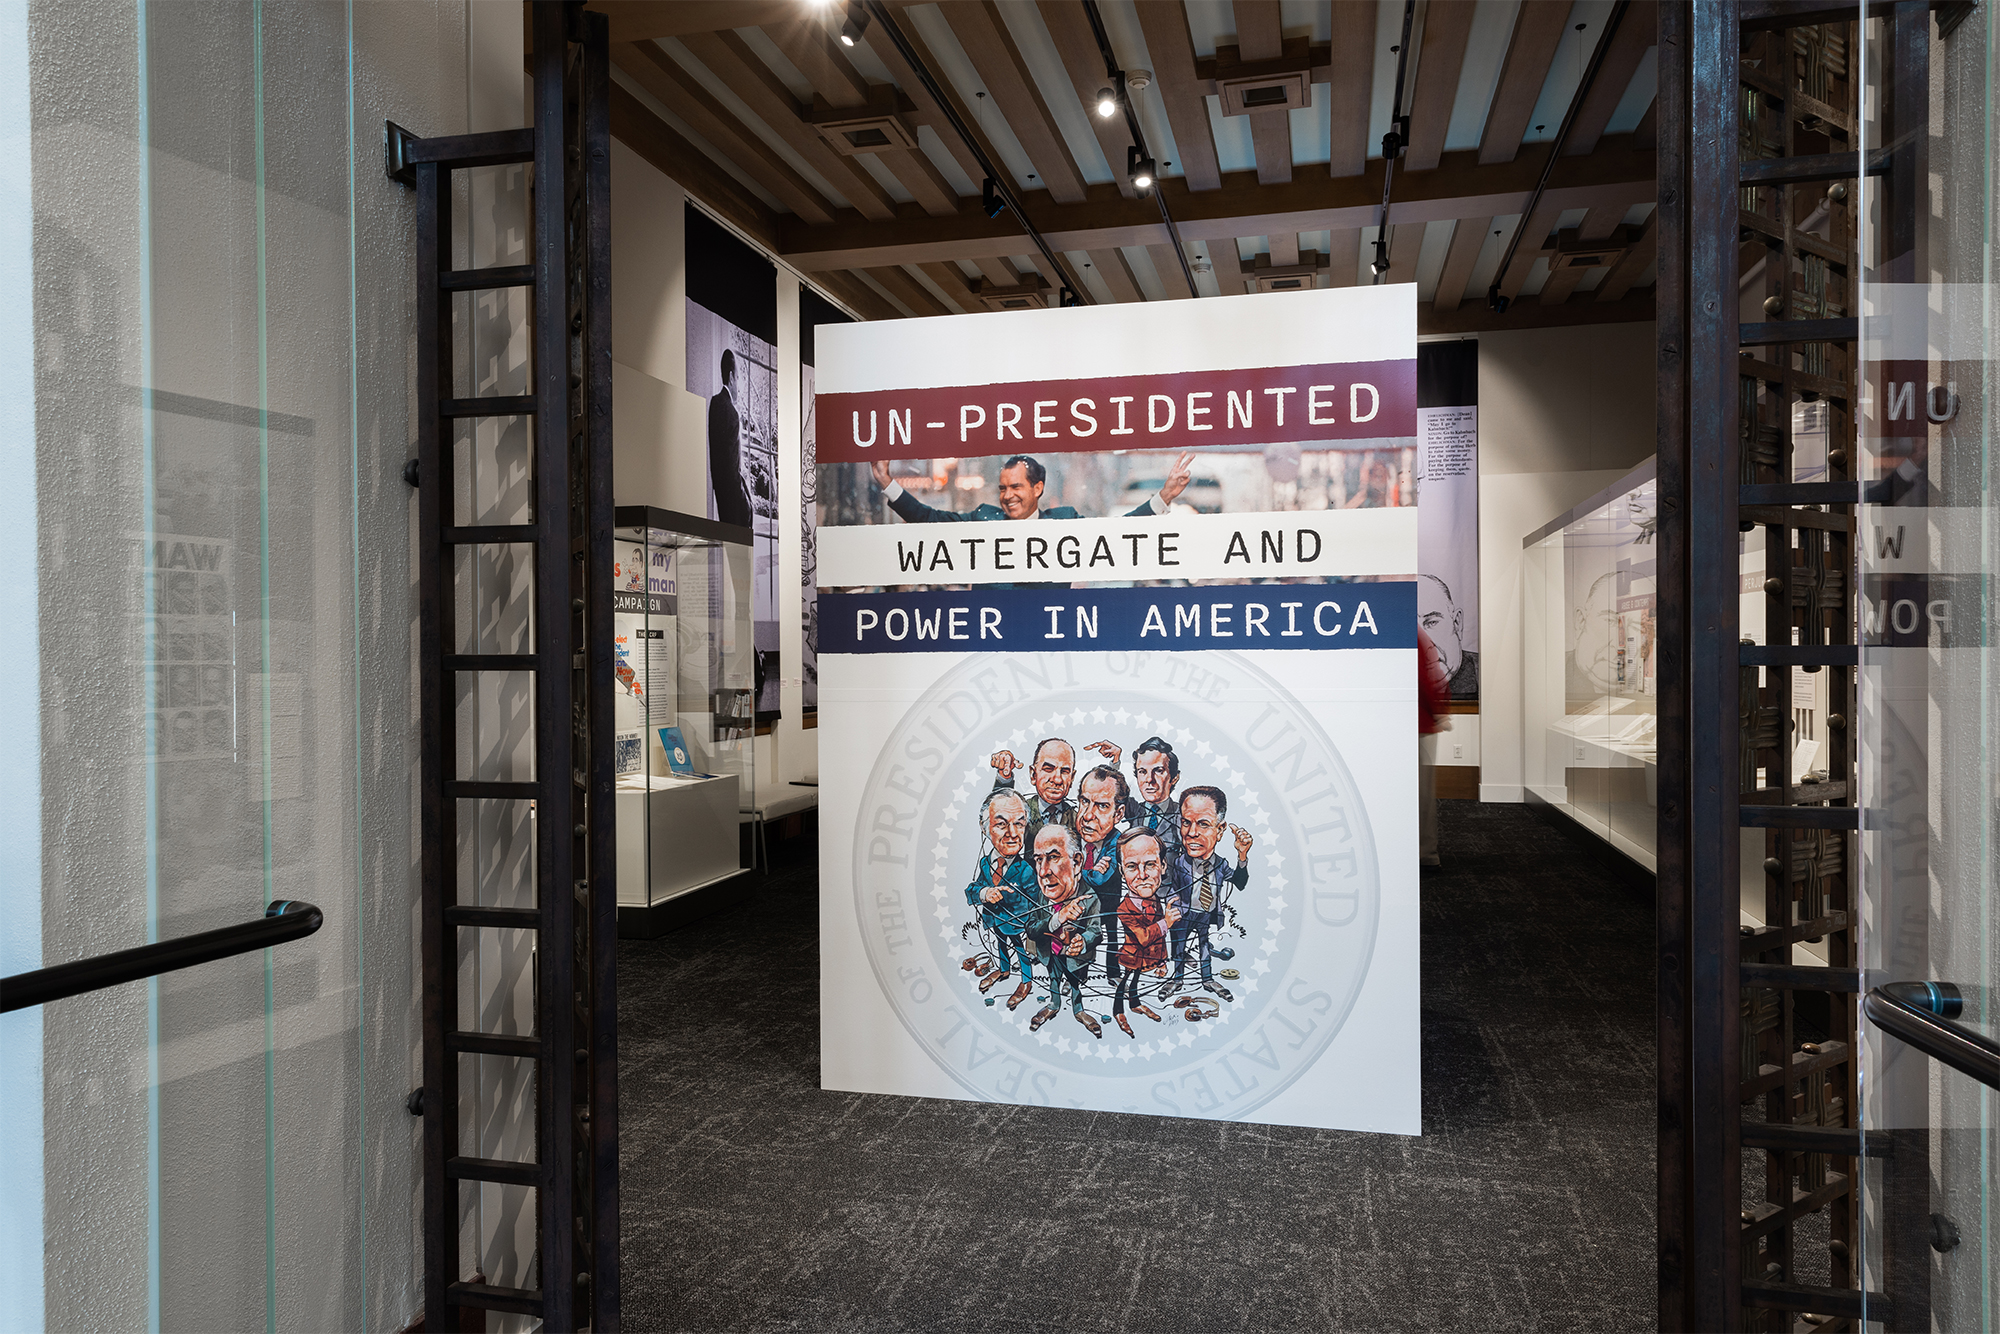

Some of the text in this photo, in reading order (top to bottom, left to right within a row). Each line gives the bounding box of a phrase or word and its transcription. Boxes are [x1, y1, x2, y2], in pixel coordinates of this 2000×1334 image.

[851, 382, 1381, 448] UN-PRESIDENTED
[653, 553, 671, 572] my
[897, 528, 1322, 573] WATERGATE AND
[614, 595, 660, 611] CAMPAGN
[649, 578, 675, 593] man
[856, 600, 1378, 641] POWER IN AMERICA
[1163, 659, 1231, 707] THE
[868, 652, 1081, 868] PRESIDENT
[1243, 707, 1360, 928] UNITED
[875, 887, 913, 955] THE
[1151, 977, 1332, 1117] STATES
